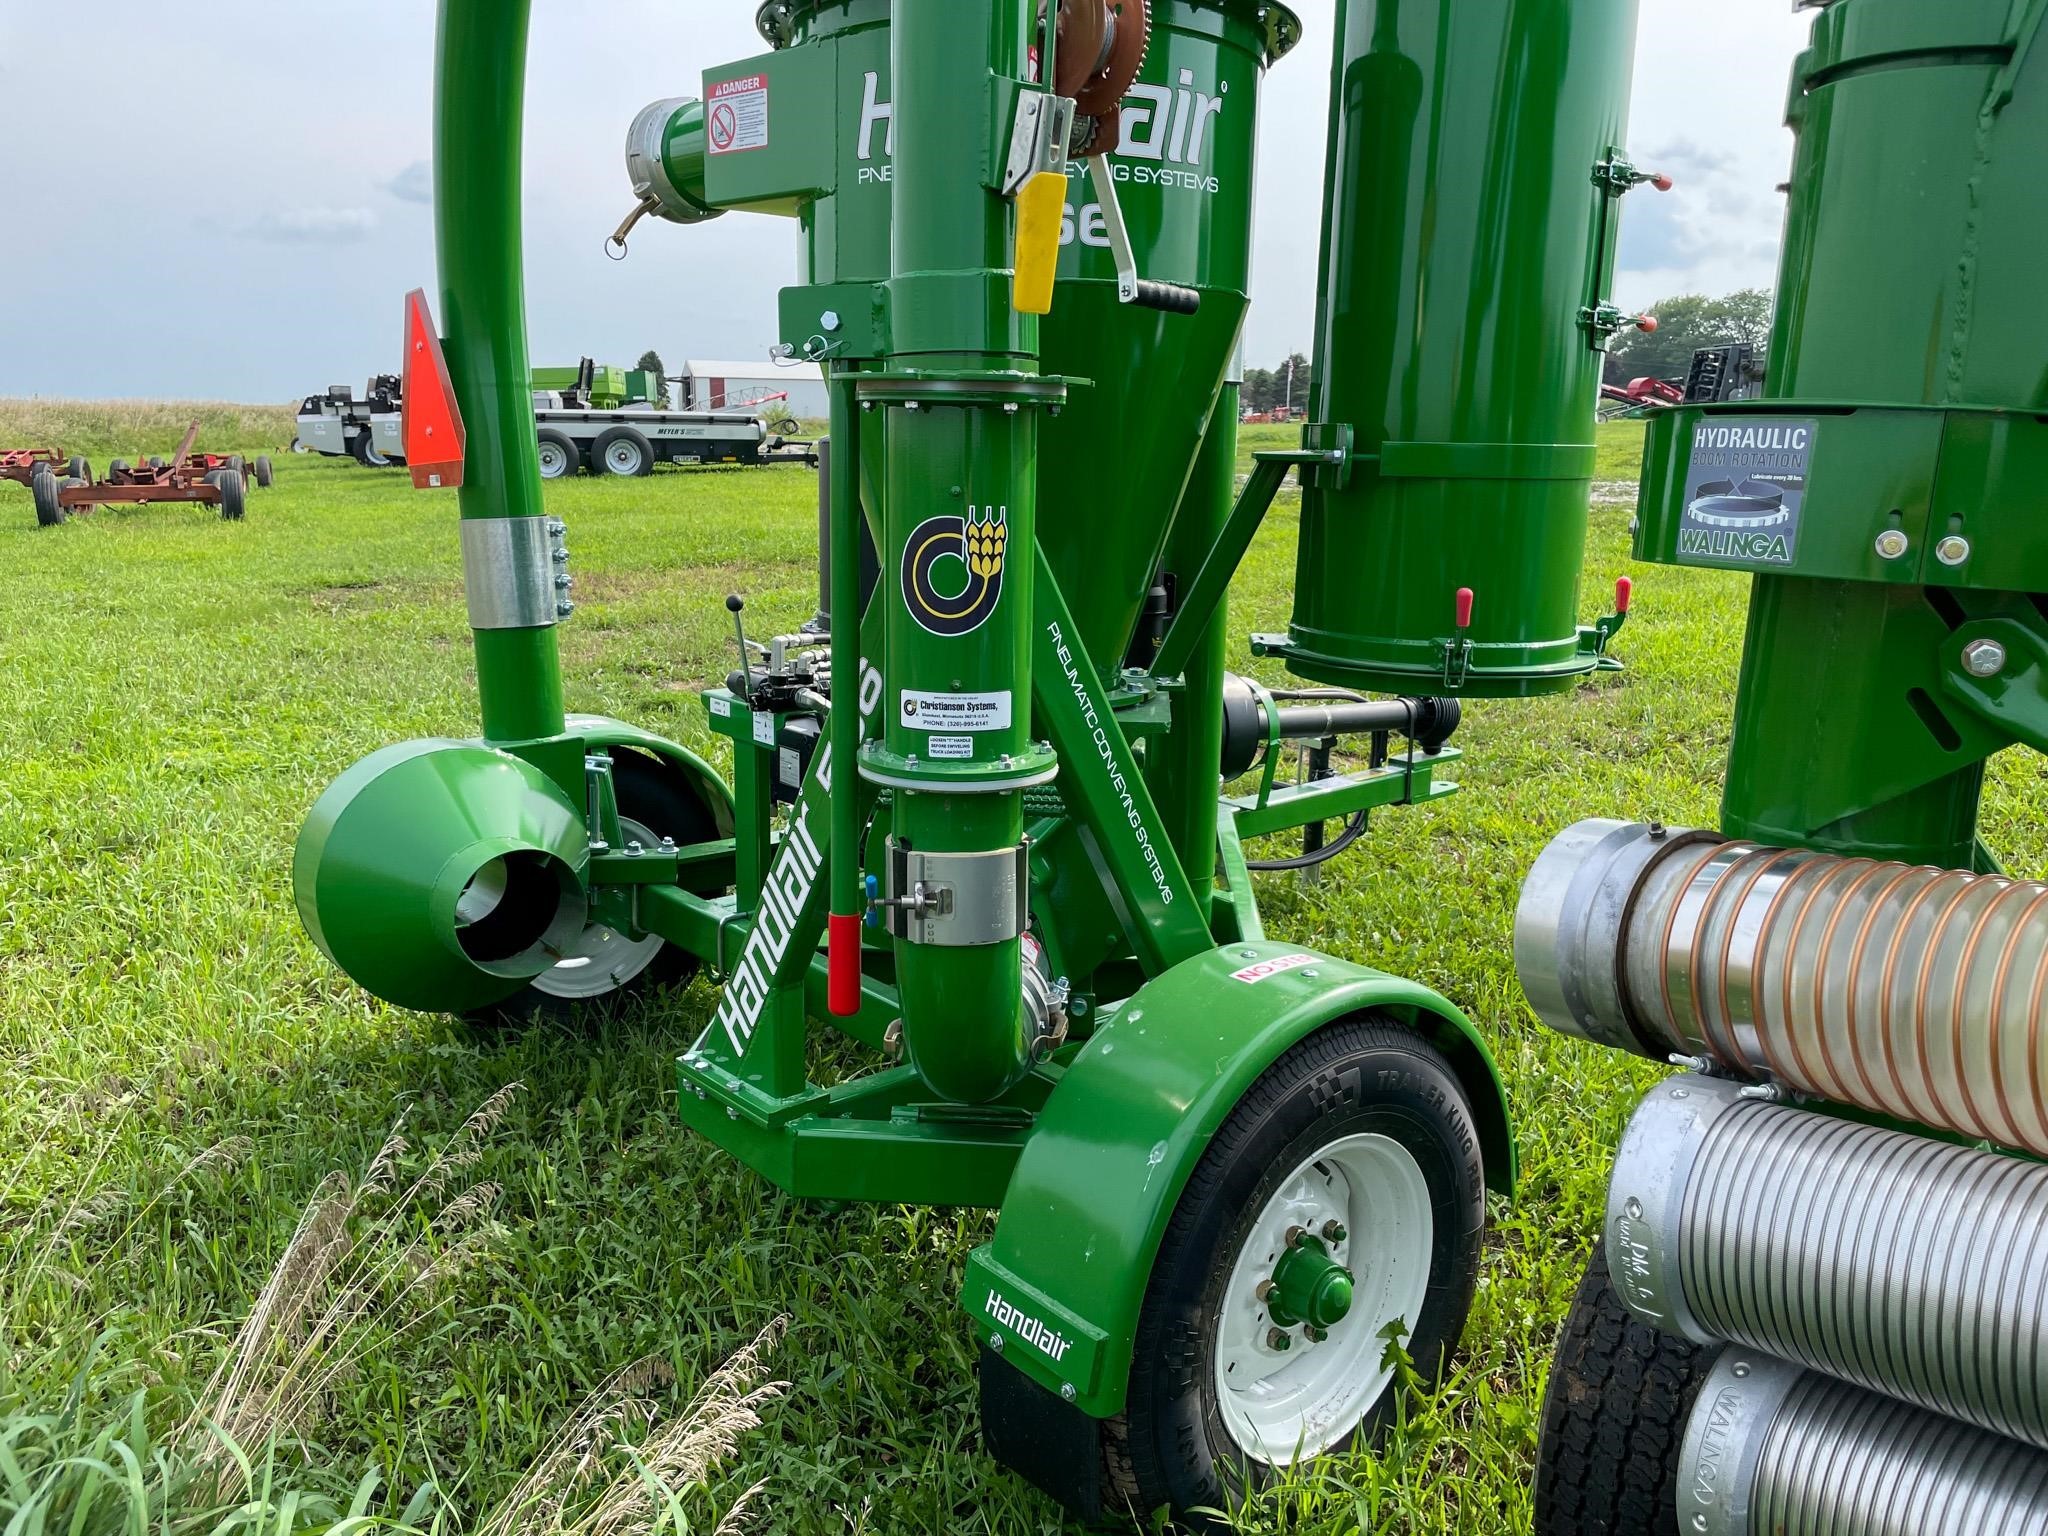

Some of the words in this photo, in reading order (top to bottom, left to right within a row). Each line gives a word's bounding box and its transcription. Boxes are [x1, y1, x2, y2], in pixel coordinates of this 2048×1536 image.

[722, 77, 760, 95] DANGER
[1134, 166, 1219, 193] SYSTEMS
[1695, 428, 1807, 449] HYDRAULIC
[1692, 451, 1726, 467] BOOM
[1730, 453, 1803, 469] ROTATION
[1680, 528, 1789, 561] WALINGA
[920, 700, 965, 711] Christianson
[967, 701, 998, 713] Systems,
[1047, 621, 1100, 729] PNEUMATIC
[1093, 728, 1142, 828] CONVEYING
[1136, 827, 1173, 905] SYSTEMS
[717, 801, 823, 1058] Handlair
[1236, 965, 1273, 981] NO
[1270, 956, 1313, 967] STEP
[1445, 1104, 1473, 1157] KING
[985, 1289, 1071, 1361] Handlair
[1697, 1392, 1741, 1494] WALINGA
